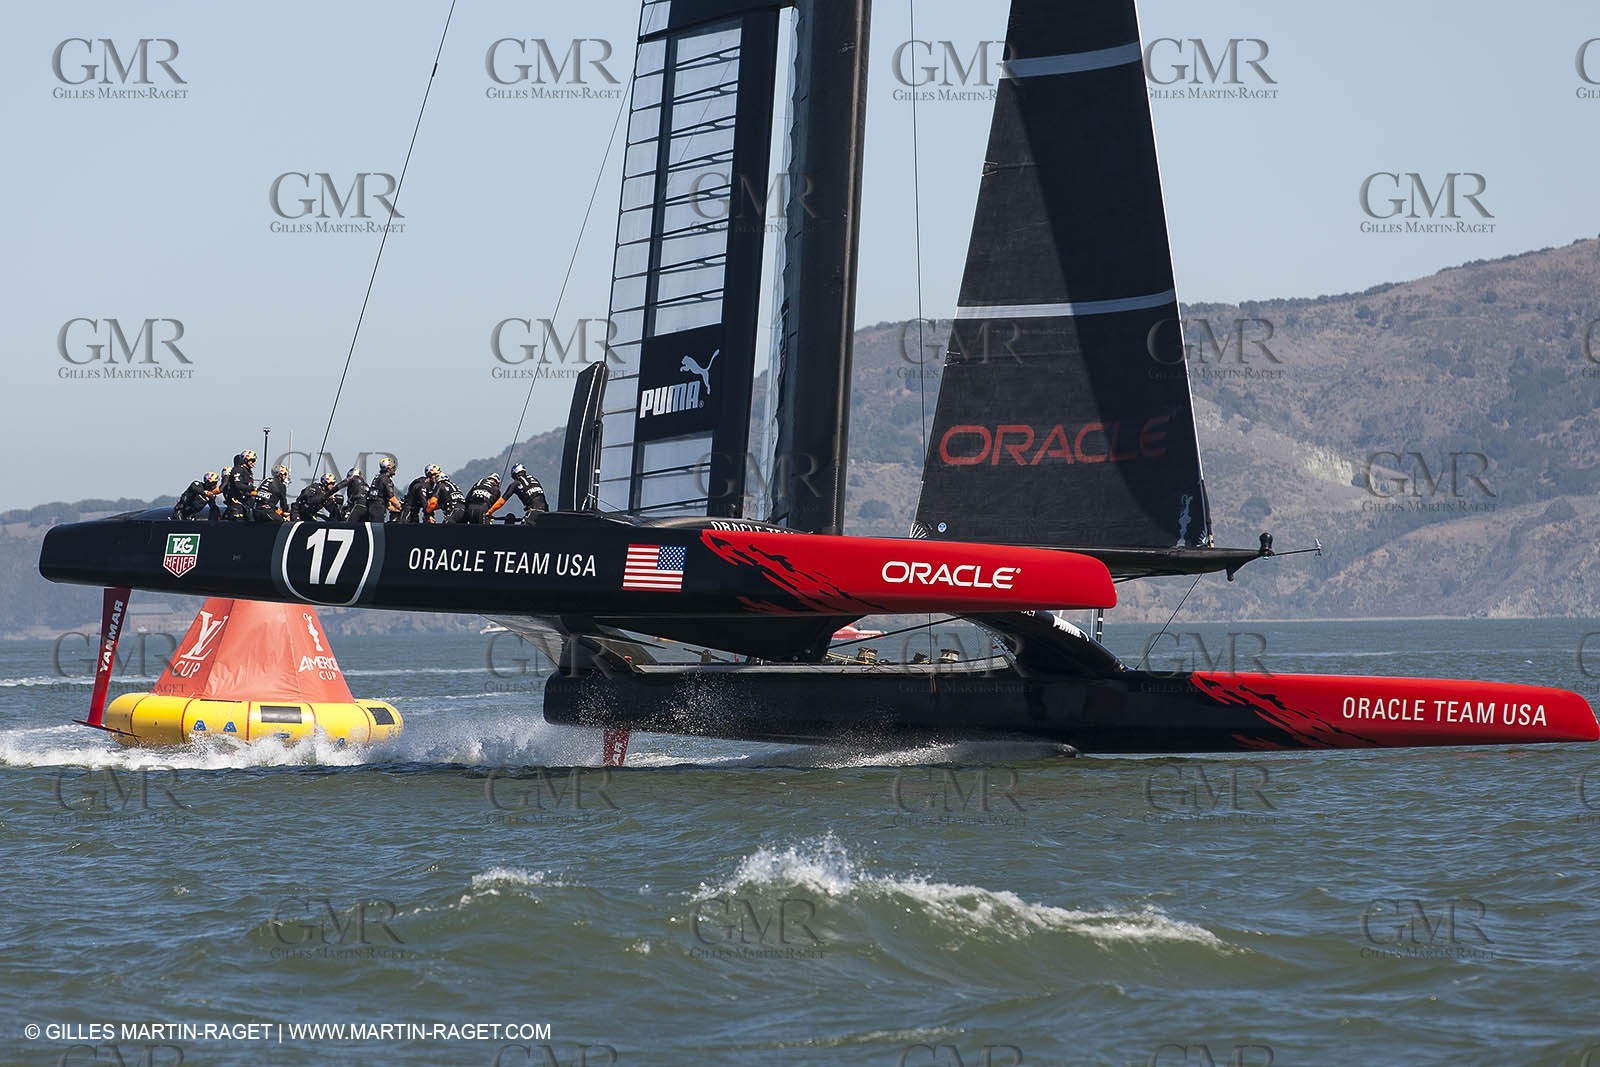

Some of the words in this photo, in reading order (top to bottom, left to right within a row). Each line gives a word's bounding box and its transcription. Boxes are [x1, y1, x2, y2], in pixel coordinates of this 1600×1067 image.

[640, 381, 700, 418] PUMA
[939, 416, 1171, 466] ORACLE
[173, 537, 194, 553] TAG
[307, 528, 355, 585] 17
[166, 556, 195, 574] HEUER
[408, 547, 485, 572] ORACLE
[493, 550, 550, 575] TEAM
[556, 553, 596, 577] USA
[881, 561, 1016, 589] ORACLE
[100, 600, 123, 673] YANMAR
[172, 660, 200, 679] CUP
[319, 670, 337, 680] CUP
[1342, 696, 1425, 720] ORACLE
[1434, 700, 1495, 724] TEAM
[1503, 703, 1547, 726] USA
